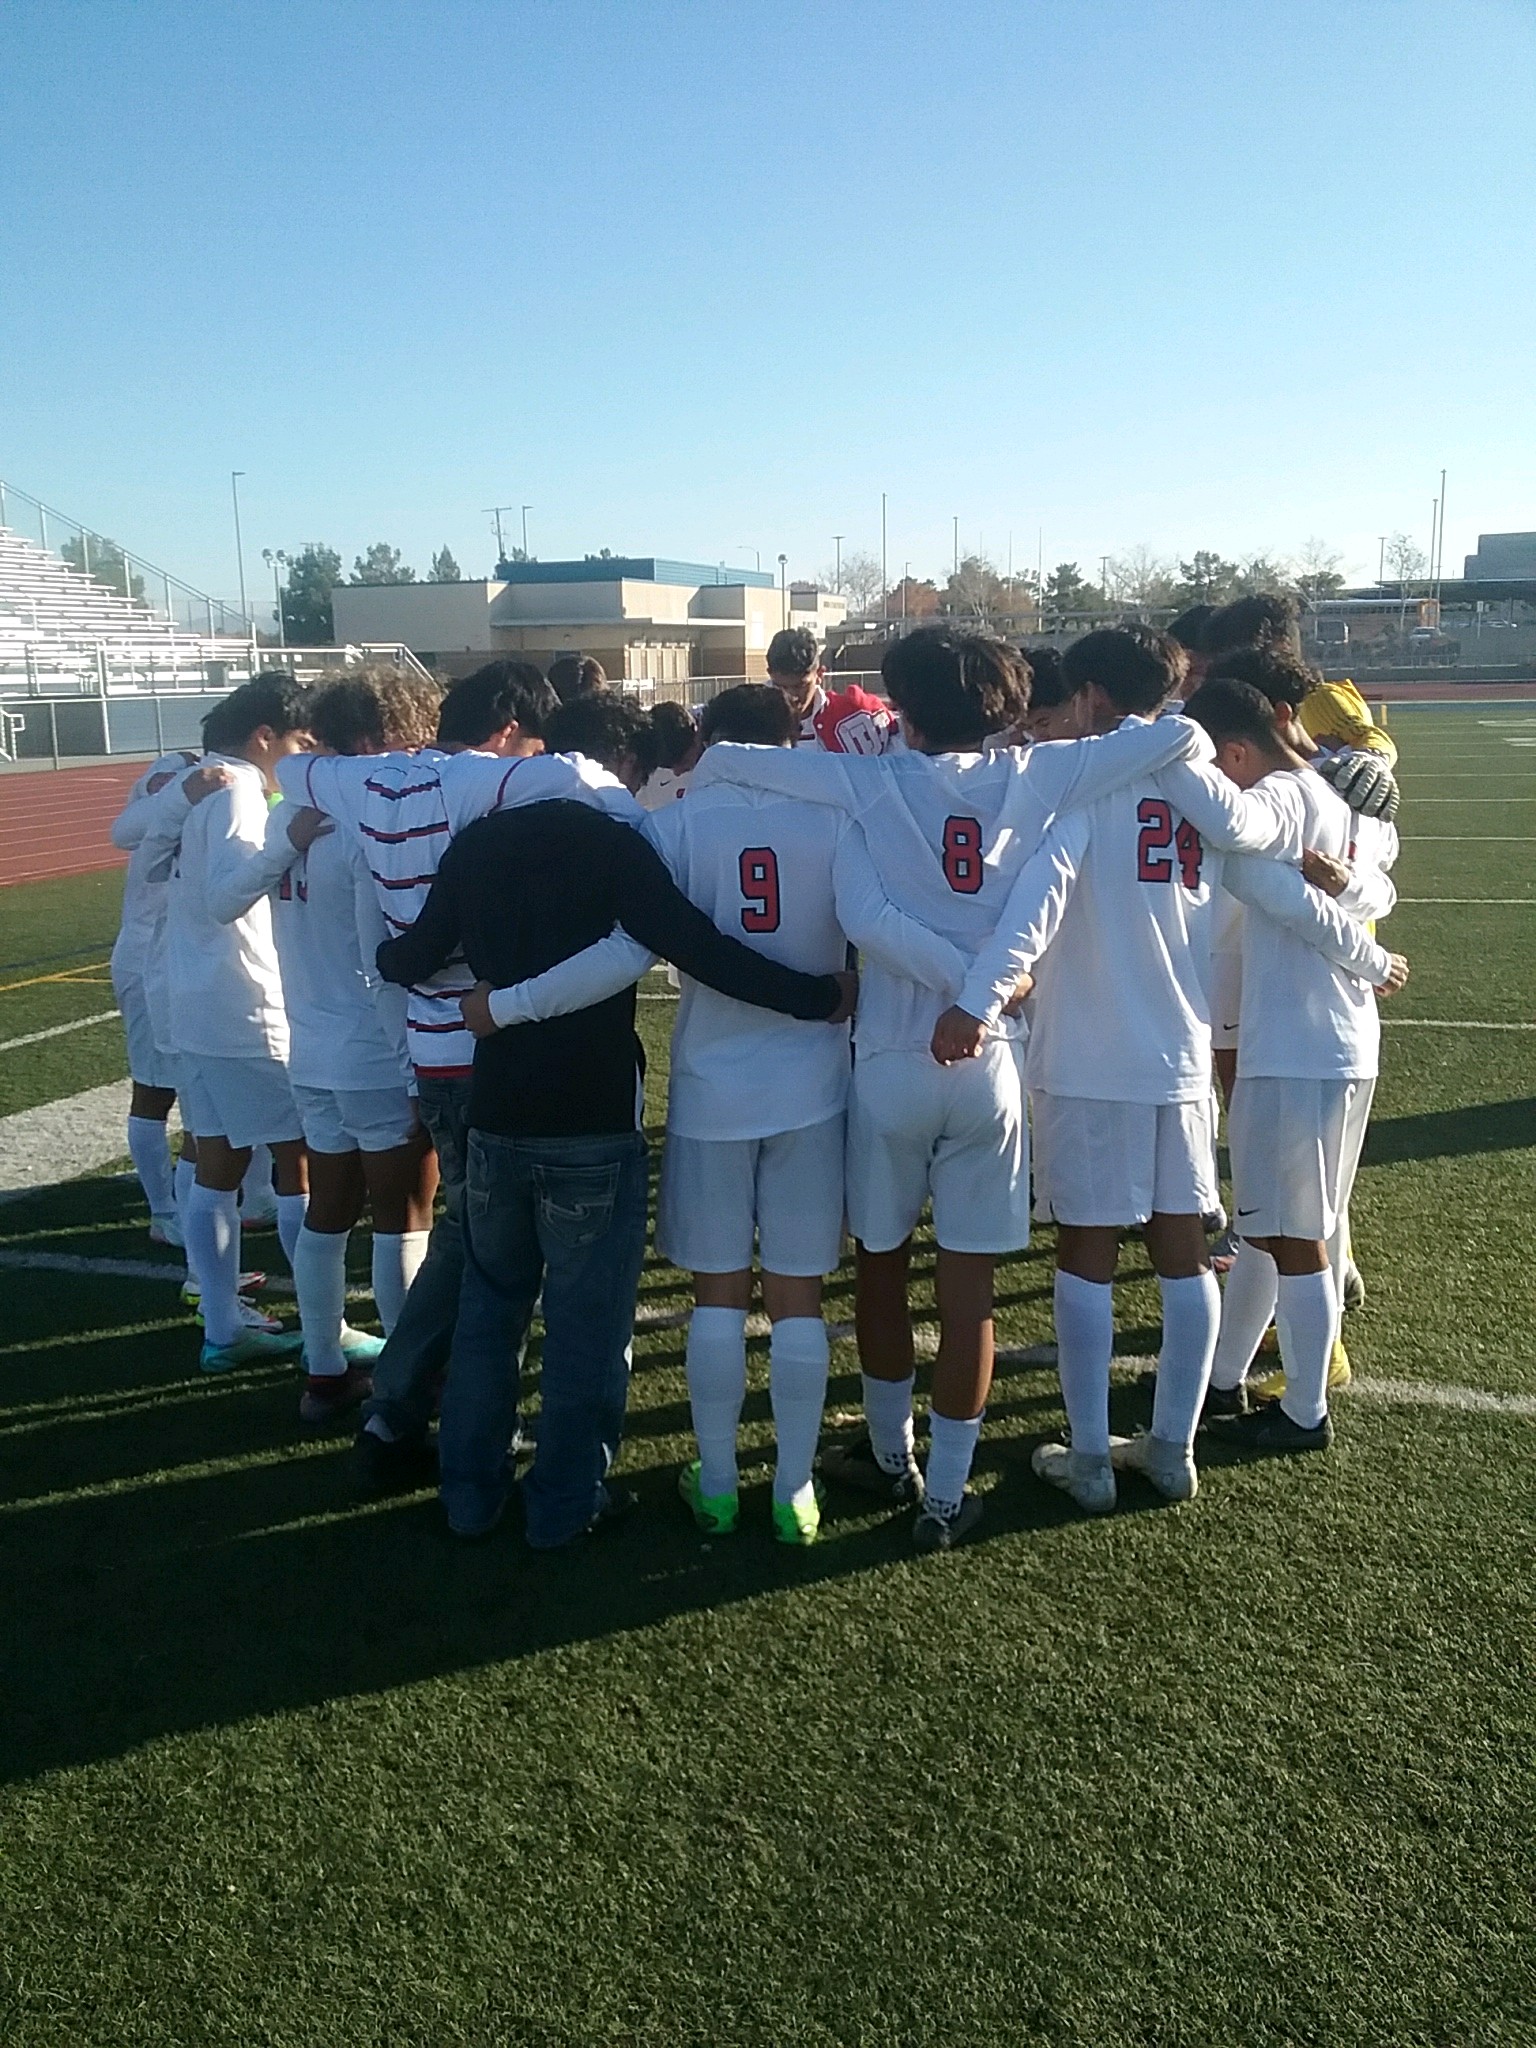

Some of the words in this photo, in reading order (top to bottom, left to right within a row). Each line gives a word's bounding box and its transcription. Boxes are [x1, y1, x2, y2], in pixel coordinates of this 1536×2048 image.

[942, 815, 983, 894] 8
[1137, 798, 1203, 889] 24
[739, 847, 781, 933] 9
